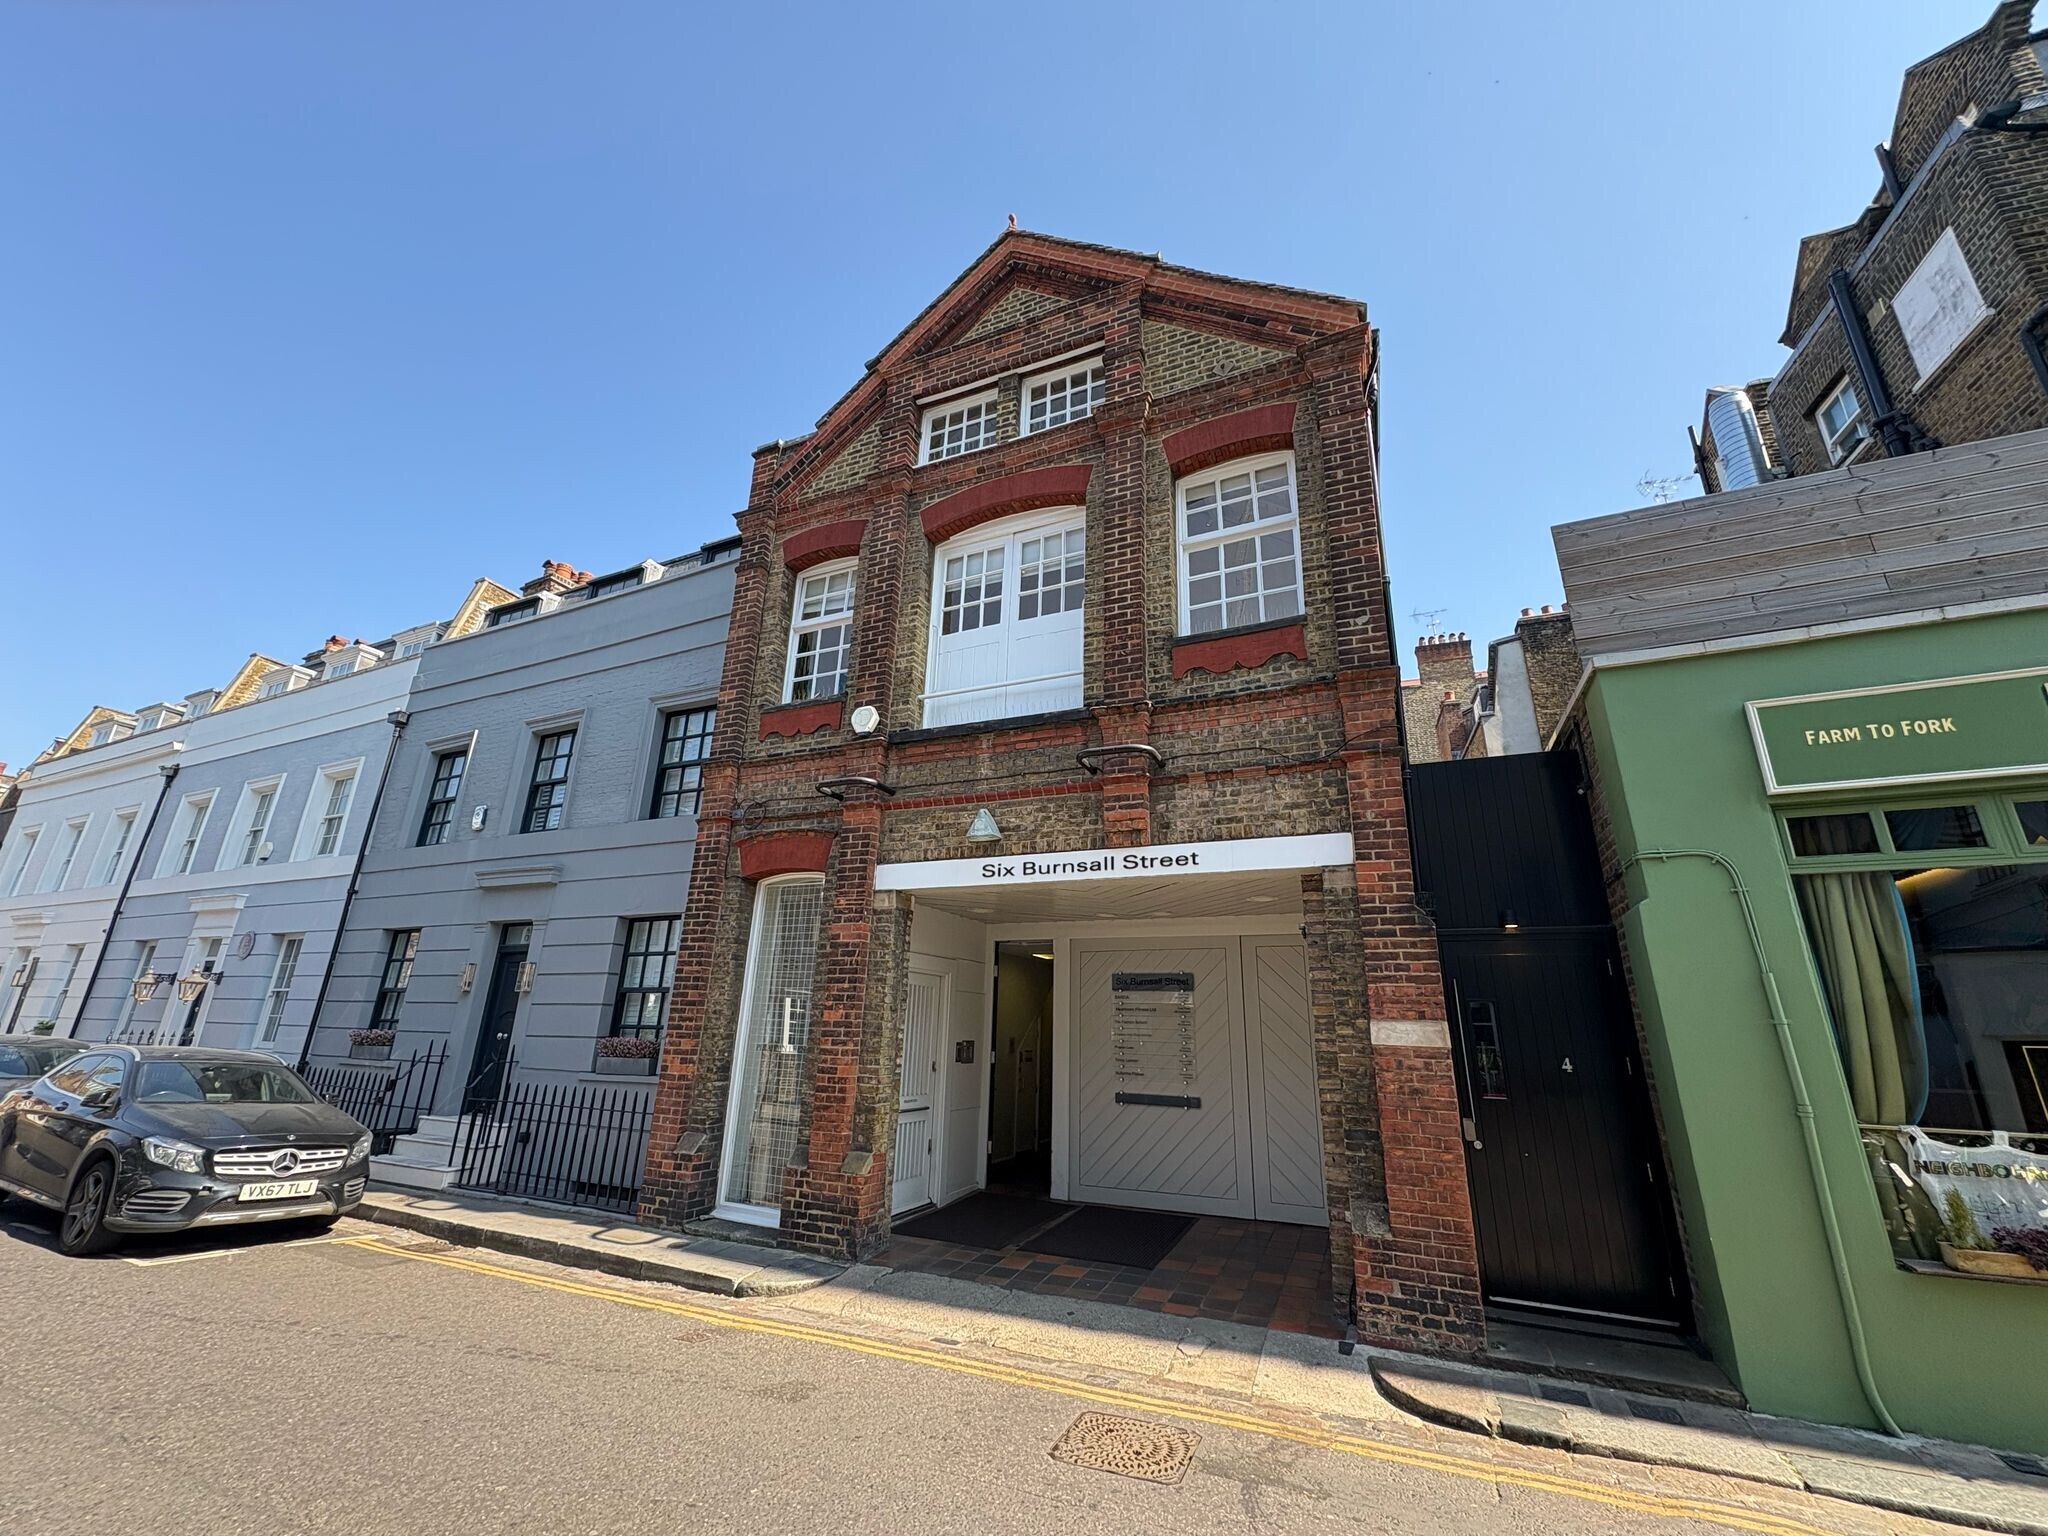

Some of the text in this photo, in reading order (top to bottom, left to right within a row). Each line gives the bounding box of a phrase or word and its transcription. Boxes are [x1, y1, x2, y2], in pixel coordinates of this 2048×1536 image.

[1804, 717, 1958, 746] FARM TO FORK
[981, 852, 1200, 878] Six Burnsall Street
[1115, 977, 1129, 986] Six
[1164, 977, 1190, 986] Street
[1561, 1057, 1573, 1073] 4
[248, 1182, 313, 1198] VX67 TLJ
